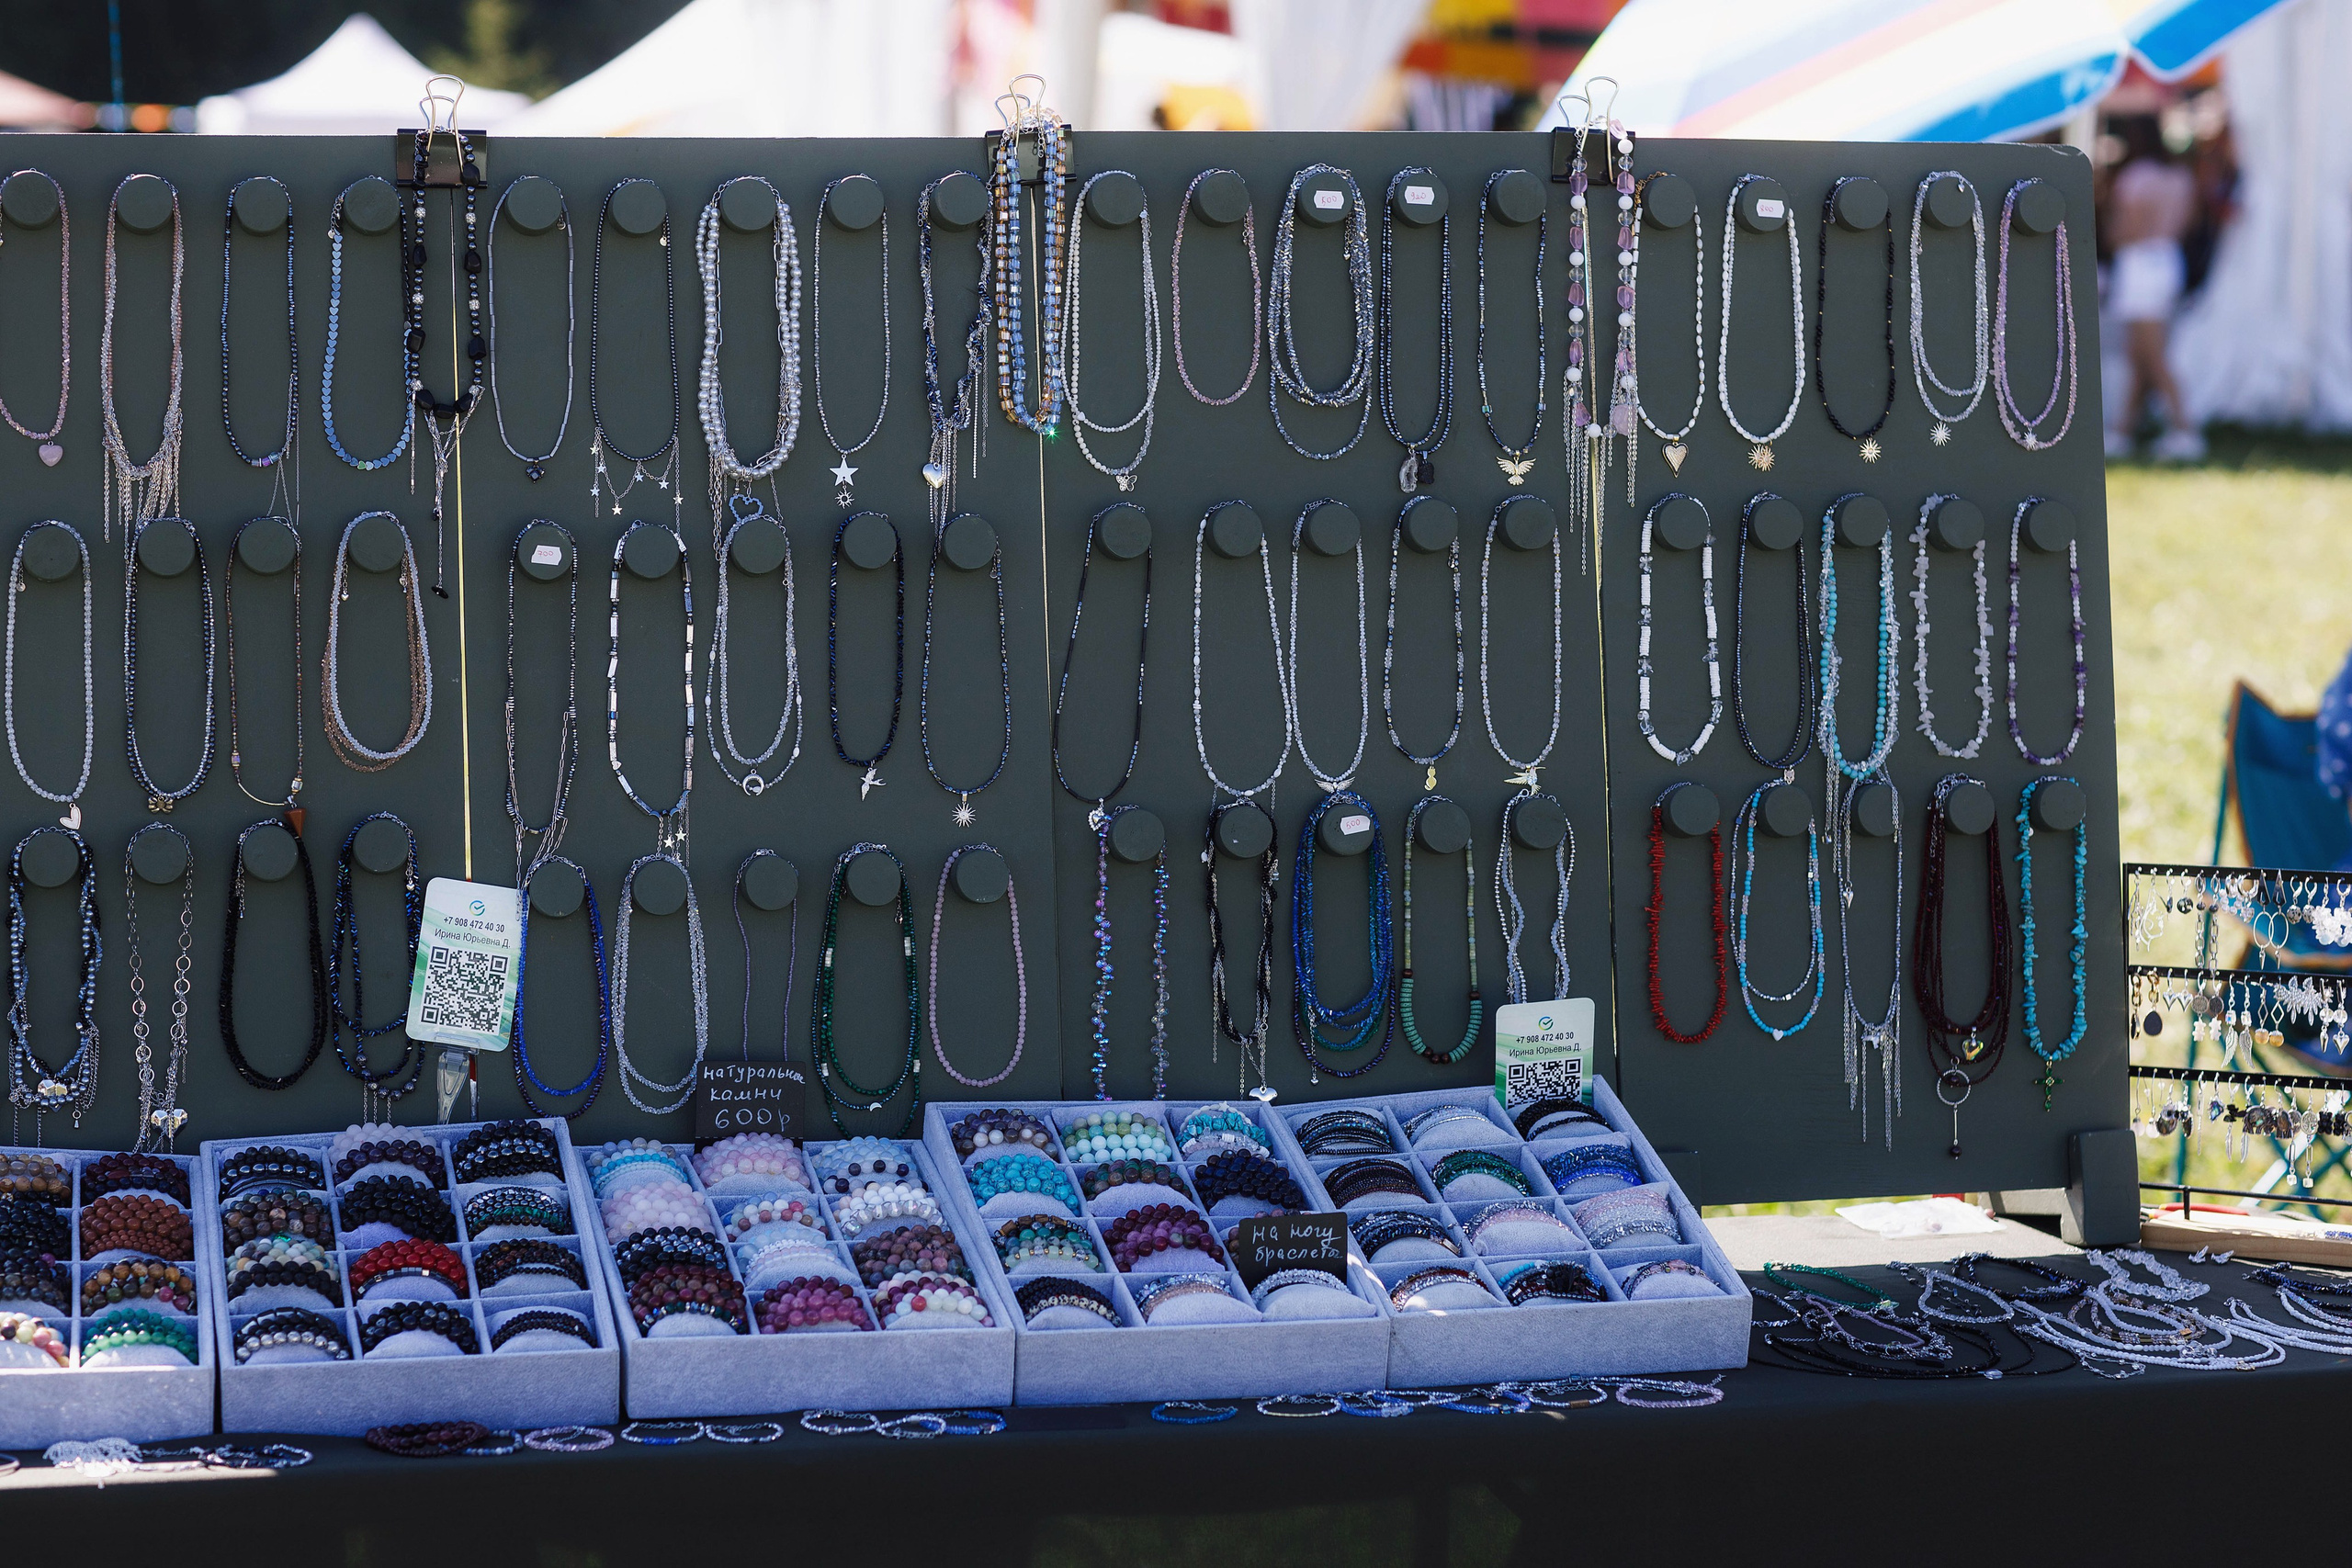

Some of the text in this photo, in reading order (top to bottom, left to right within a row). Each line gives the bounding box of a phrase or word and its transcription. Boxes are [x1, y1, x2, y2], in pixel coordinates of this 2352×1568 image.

[443, 916, 505, 932] +7 908 472 40 30
[435, 928, 511, 949] Ирина Юрьевна Д.
[1526, 1034, 1539, 1043] 908
[1541, 1033, 1554, 1042] 472
[1555, 1032, 1564, 1041] 40
[1566, 1032, 1574, 1040] 30
[1510, 1043, 1581, 1058] Ирина Юрьевна Д.
[710, 1088, 783, 1101] камни
